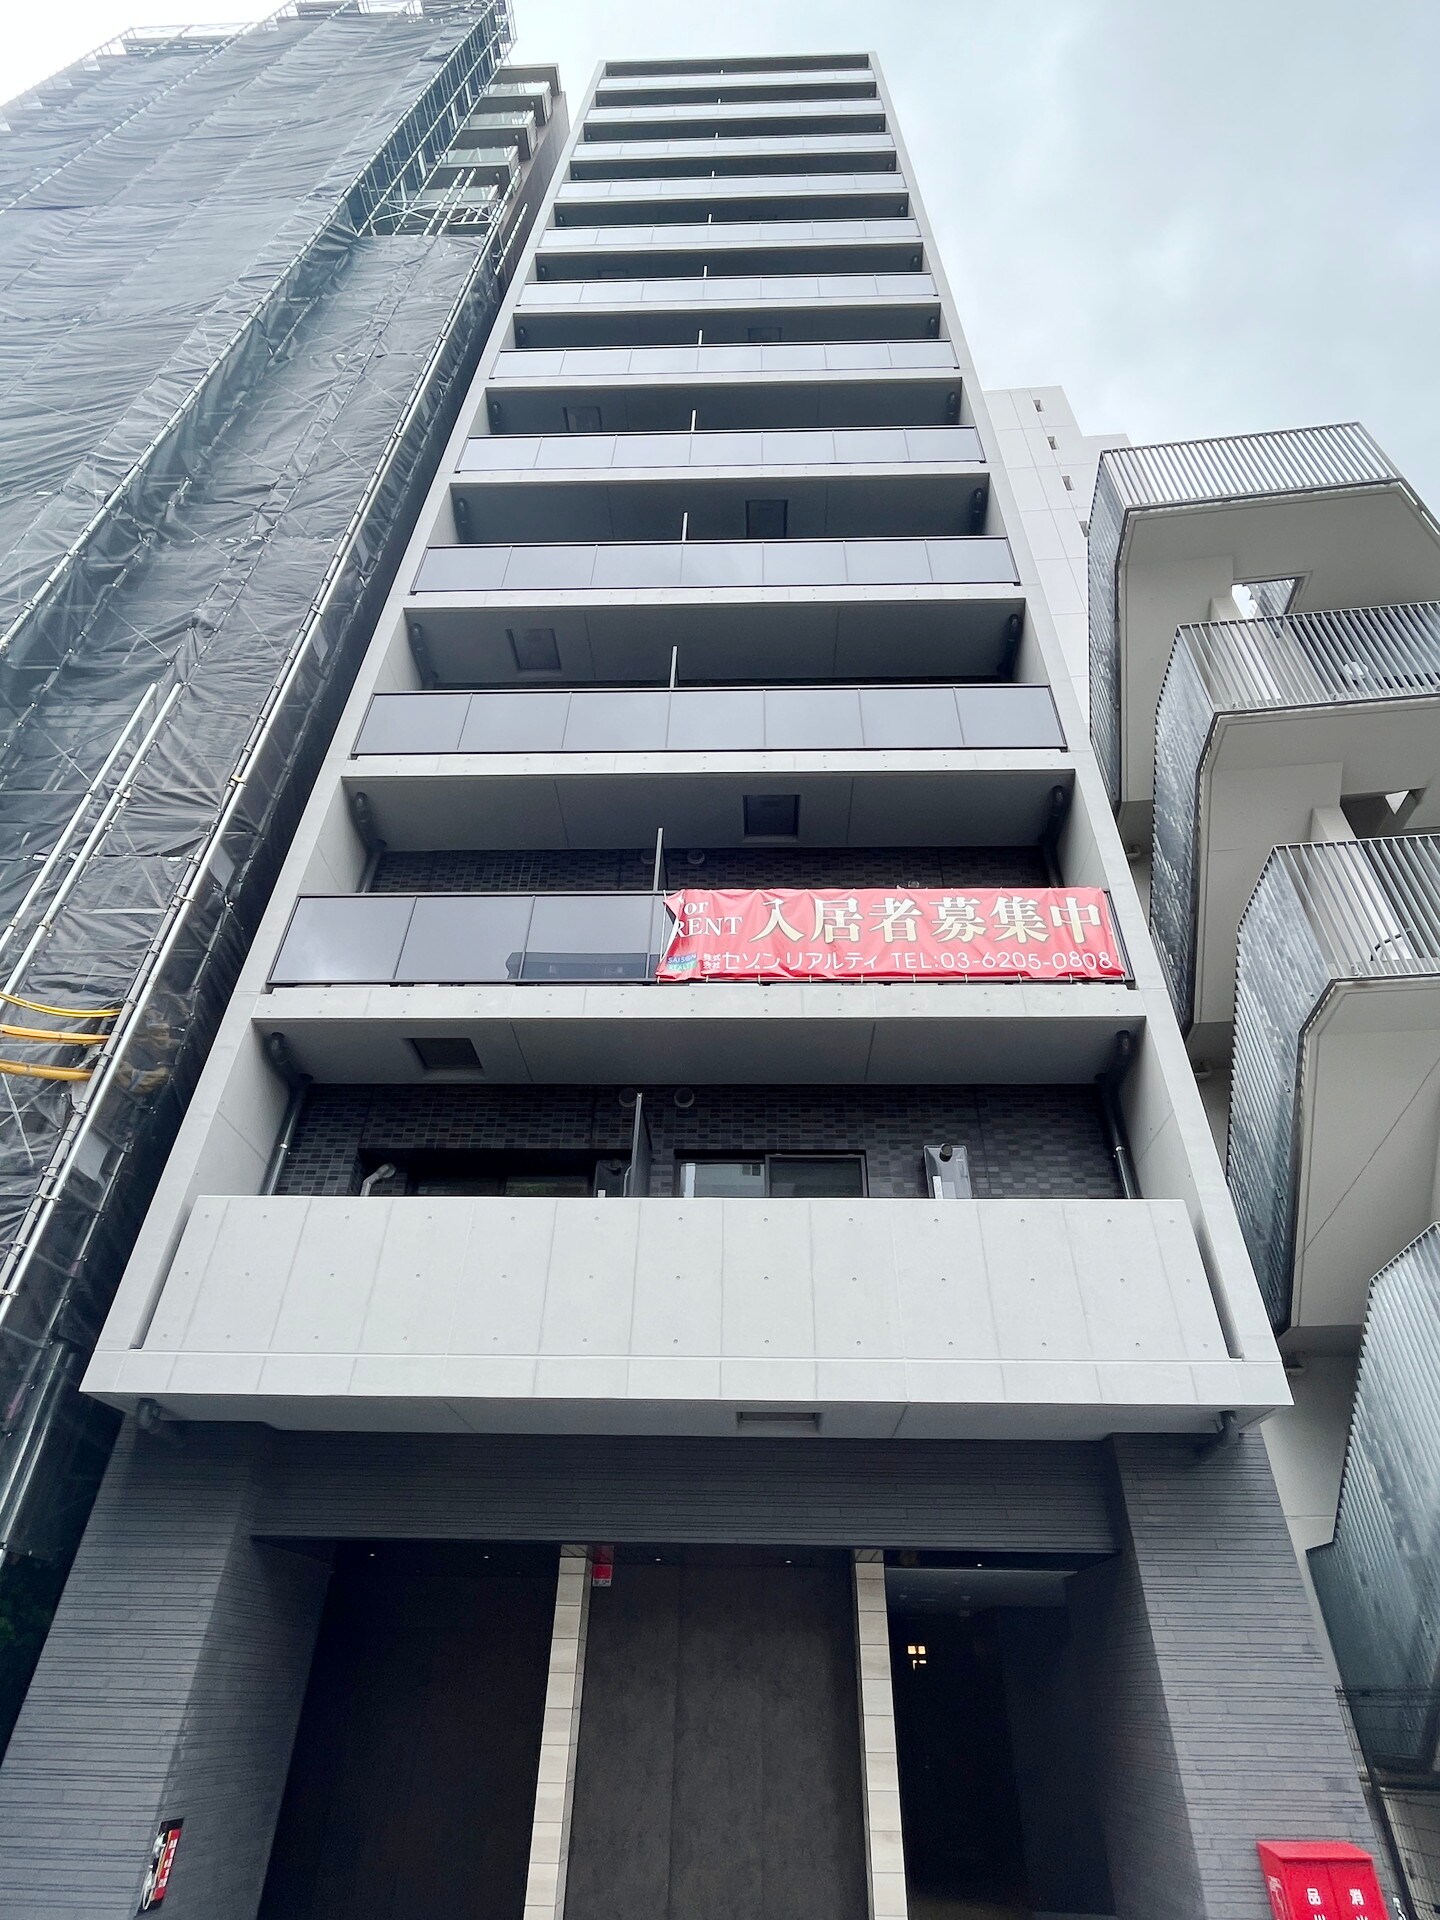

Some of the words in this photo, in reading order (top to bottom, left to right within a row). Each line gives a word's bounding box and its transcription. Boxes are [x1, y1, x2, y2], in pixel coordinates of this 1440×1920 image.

[682, 901, 709, 915] or
[748, 895, 1101, 944] 入居者募集中
